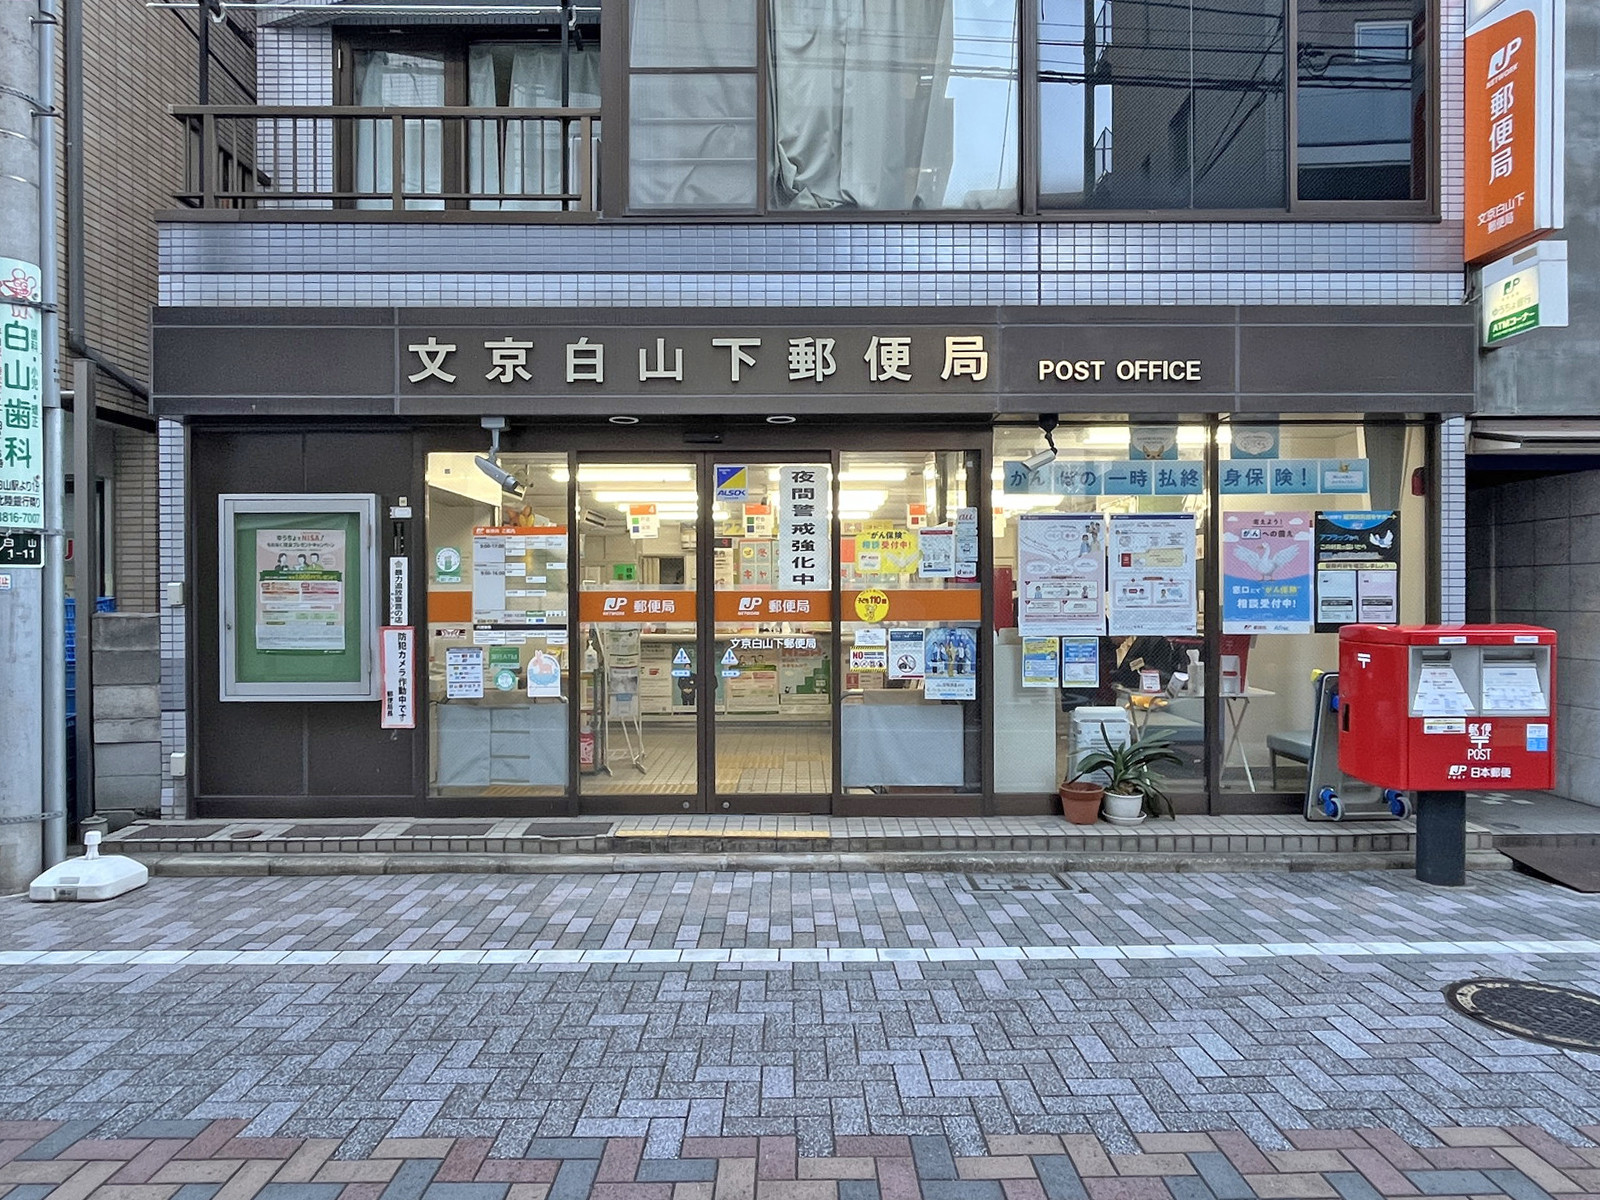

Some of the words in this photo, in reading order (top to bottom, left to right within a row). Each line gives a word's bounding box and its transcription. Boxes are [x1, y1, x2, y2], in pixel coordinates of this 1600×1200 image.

[1488, 36, 1522, 80] JP
[1488, 80, 1514, 186] 郵便局
[1477, 191, 1525, 227] 文京白山下
[1492, 312, 1536, 333] ATMコーナー
[407, 337, 989, 384] 文京白山下郵便局
[1038, 359, 1105, 382] POST
[1115, 359, 1202, 382] OFFICE
[4, 320, 31, 469] 白山歯科
[959, 513, 974, 521] au
[791, 470, 815, 586] 夜間警戒強化中
[8, 549, 35, 559] 1-11
[604, 597, 628, 611] JP
[633, 599, 675, 613] 郵便局
[739, 597, 762, 611] JP
[768, 599, 810, 613] 郵便局
[1236, 598, 1297, 609] 相談受付中!
[730, 637, 817, 650] 文京白山下郵便局
[852, 650, 864, 660] NO
[397, 632, 408, 723] 防犯カメラ作動中です
[1468, 723, 1492, 737] 郵便
[1467, 748, 1492, 761] POST
[1448, 765, 1468, 776] JP
[1470, 766, 1512, 778] 日本郵便
